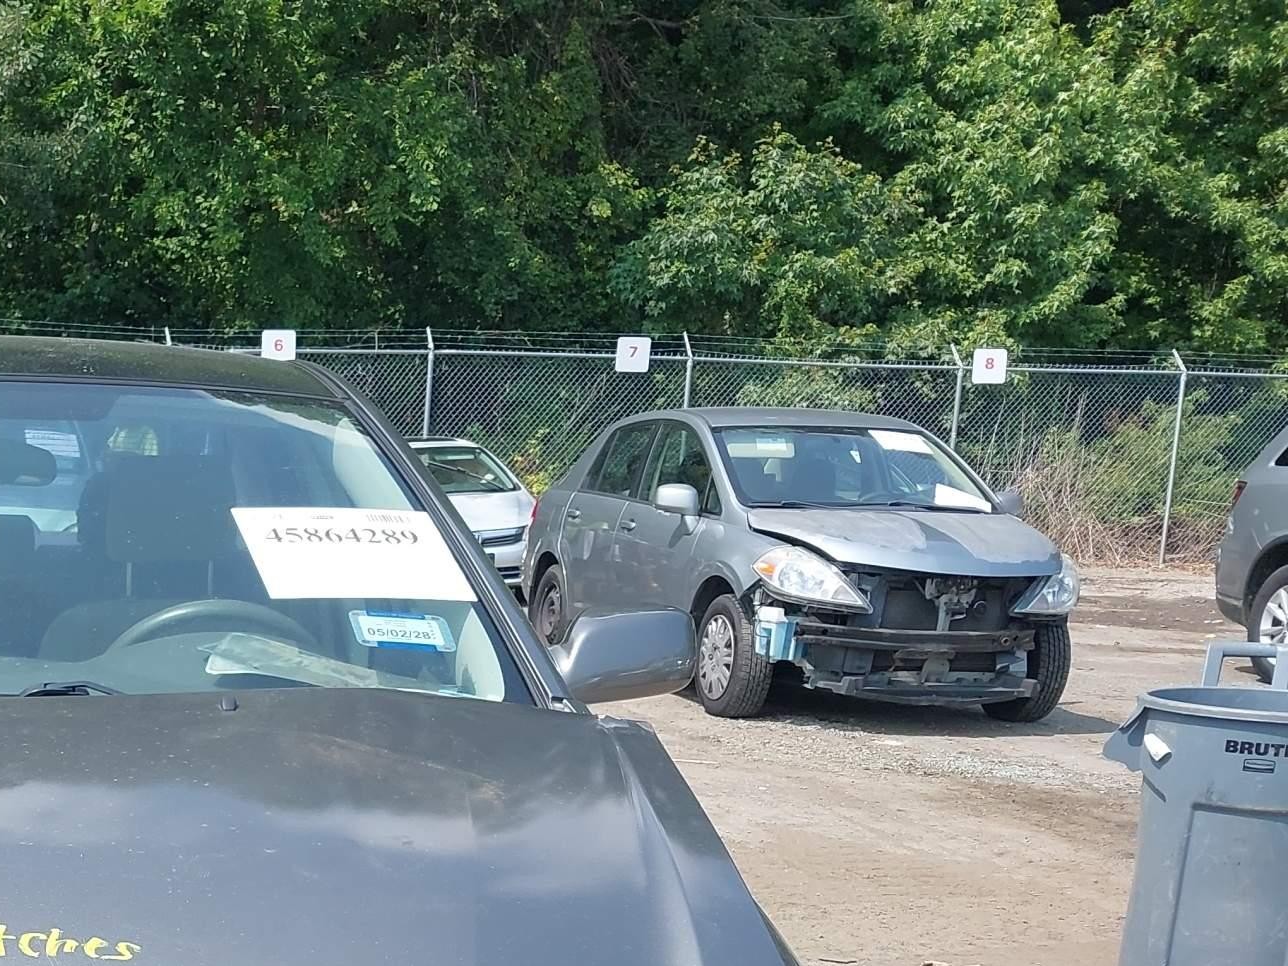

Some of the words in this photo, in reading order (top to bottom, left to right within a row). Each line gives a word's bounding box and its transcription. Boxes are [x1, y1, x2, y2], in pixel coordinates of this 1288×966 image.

[274, 340, 283, 352] 6
[629, 346, 638, 358] 7
[986, 358, 995, 369] 8
[265, 527, 419, 544] 45864289
[367, 627, 431, 640] 05/02/28
